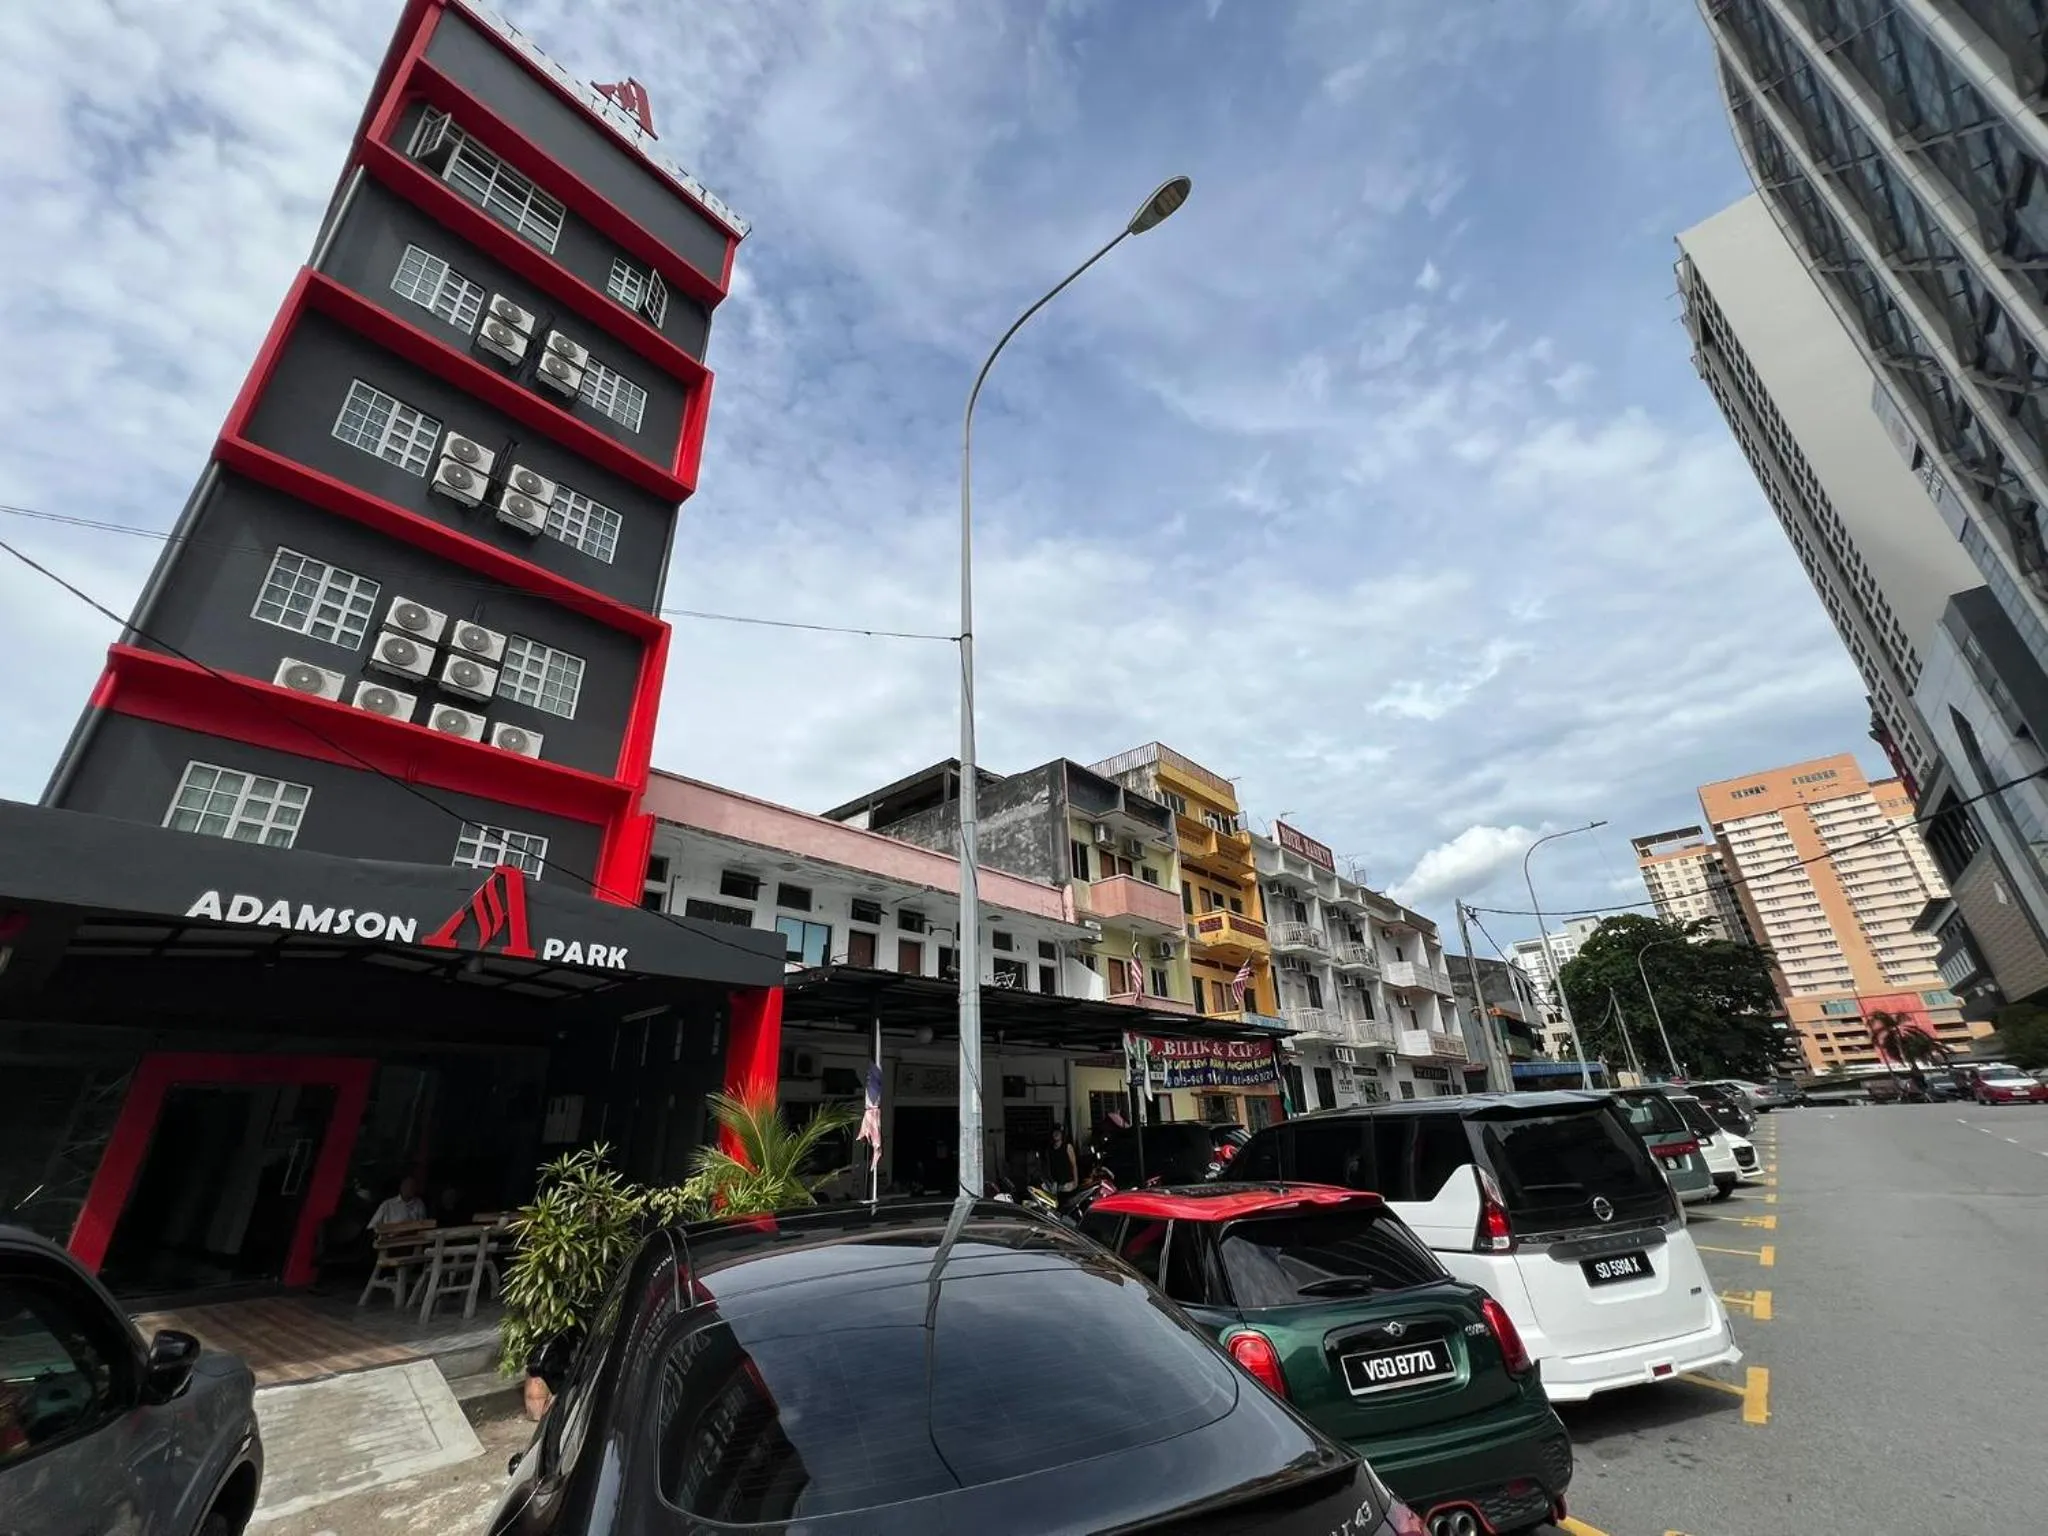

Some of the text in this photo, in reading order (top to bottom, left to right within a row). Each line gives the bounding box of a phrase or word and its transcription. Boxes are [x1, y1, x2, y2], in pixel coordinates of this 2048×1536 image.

[186, 890, 629, 970] ADAMSON PARK
[1630, 1256, 1642, 1272] X
[1395, 1350, 1436, 1375] 8770
[1355, 1500, 1373, 1528] 43
